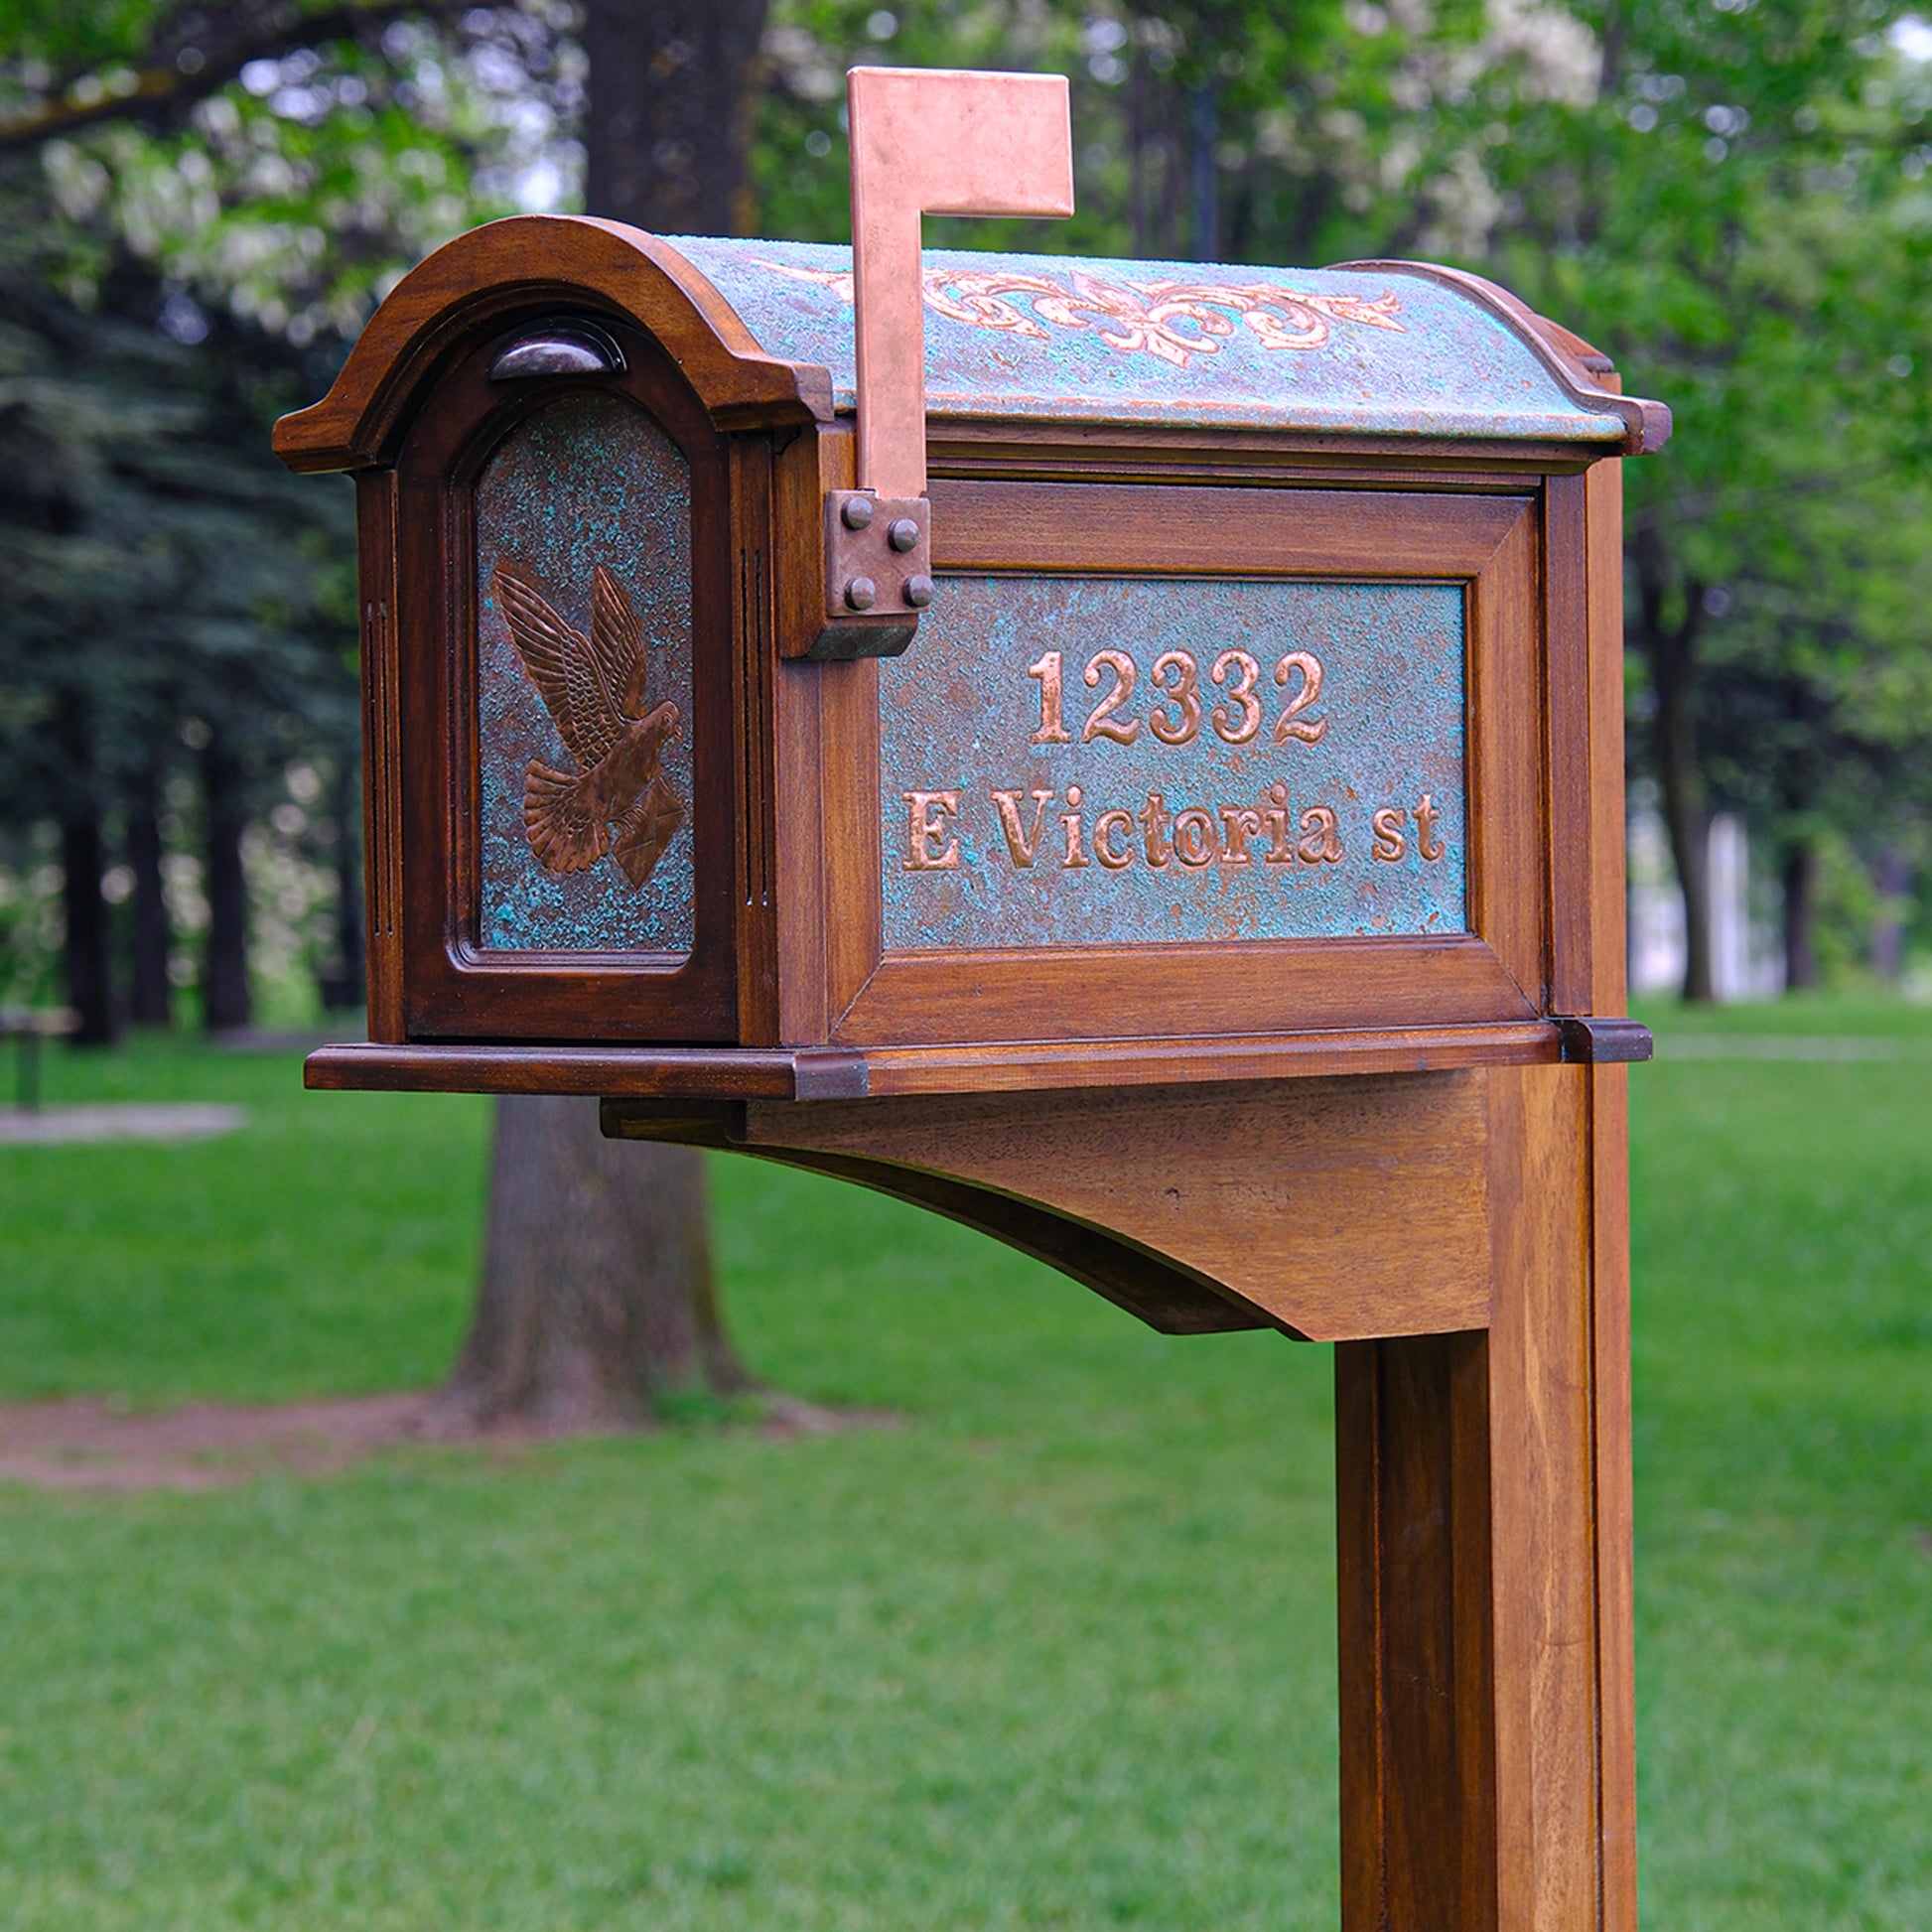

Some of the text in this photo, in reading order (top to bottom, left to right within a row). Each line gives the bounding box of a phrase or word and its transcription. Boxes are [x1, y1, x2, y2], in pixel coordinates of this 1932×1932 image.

[1028, 648, 1328, 746] 12332
[901, 781, 1446, 872] E Victoria st
